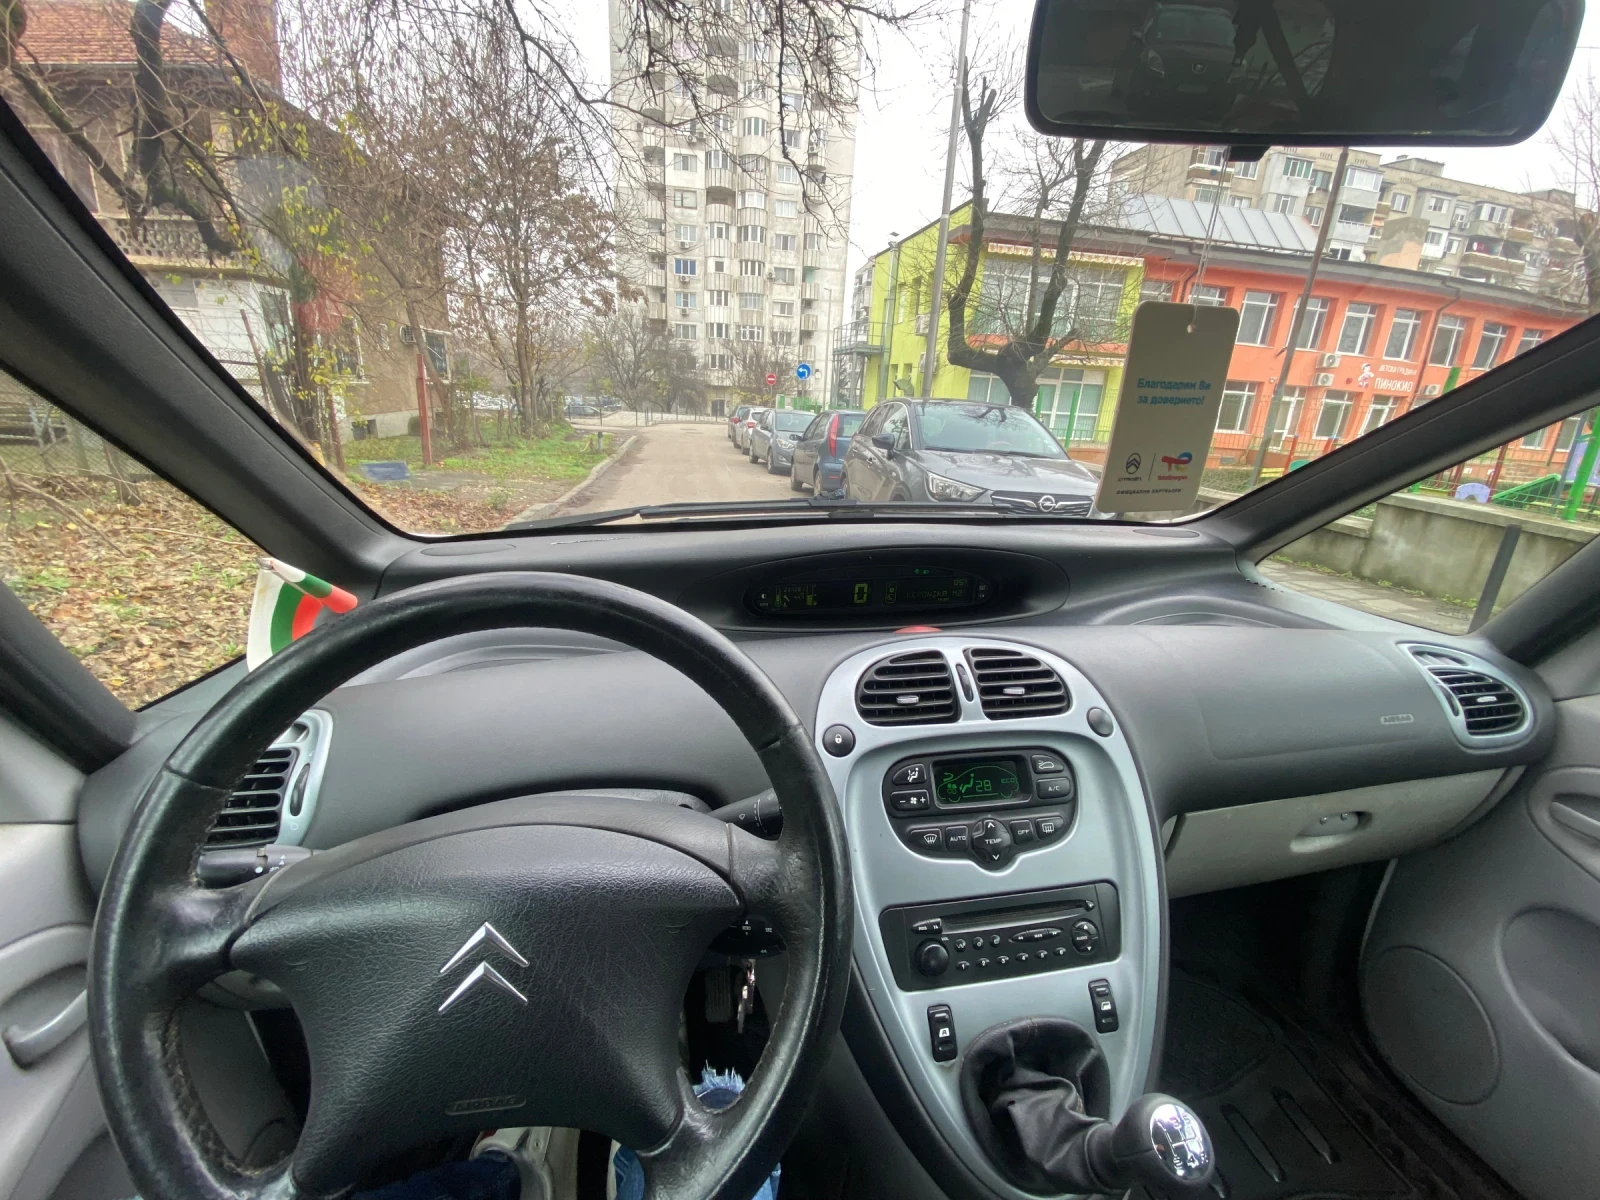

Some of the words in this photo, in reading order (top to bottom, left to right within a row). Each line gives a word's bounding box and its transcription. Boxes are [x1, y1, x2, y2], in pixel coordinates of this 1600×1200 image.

[1137, 378, 1196, 391] Благодарим
[1198, 380, 1212, 391] Ви
[1373, 377, 1414, 393] ПИНОКИО
[1136, 395, 1148, 404] за
[1149, 395, 1206, 406] доверието!
[853, 583, 869, 604] 0
[975, 780, 992, 792] 28
[984, 837, 1002, 845] TEMP
